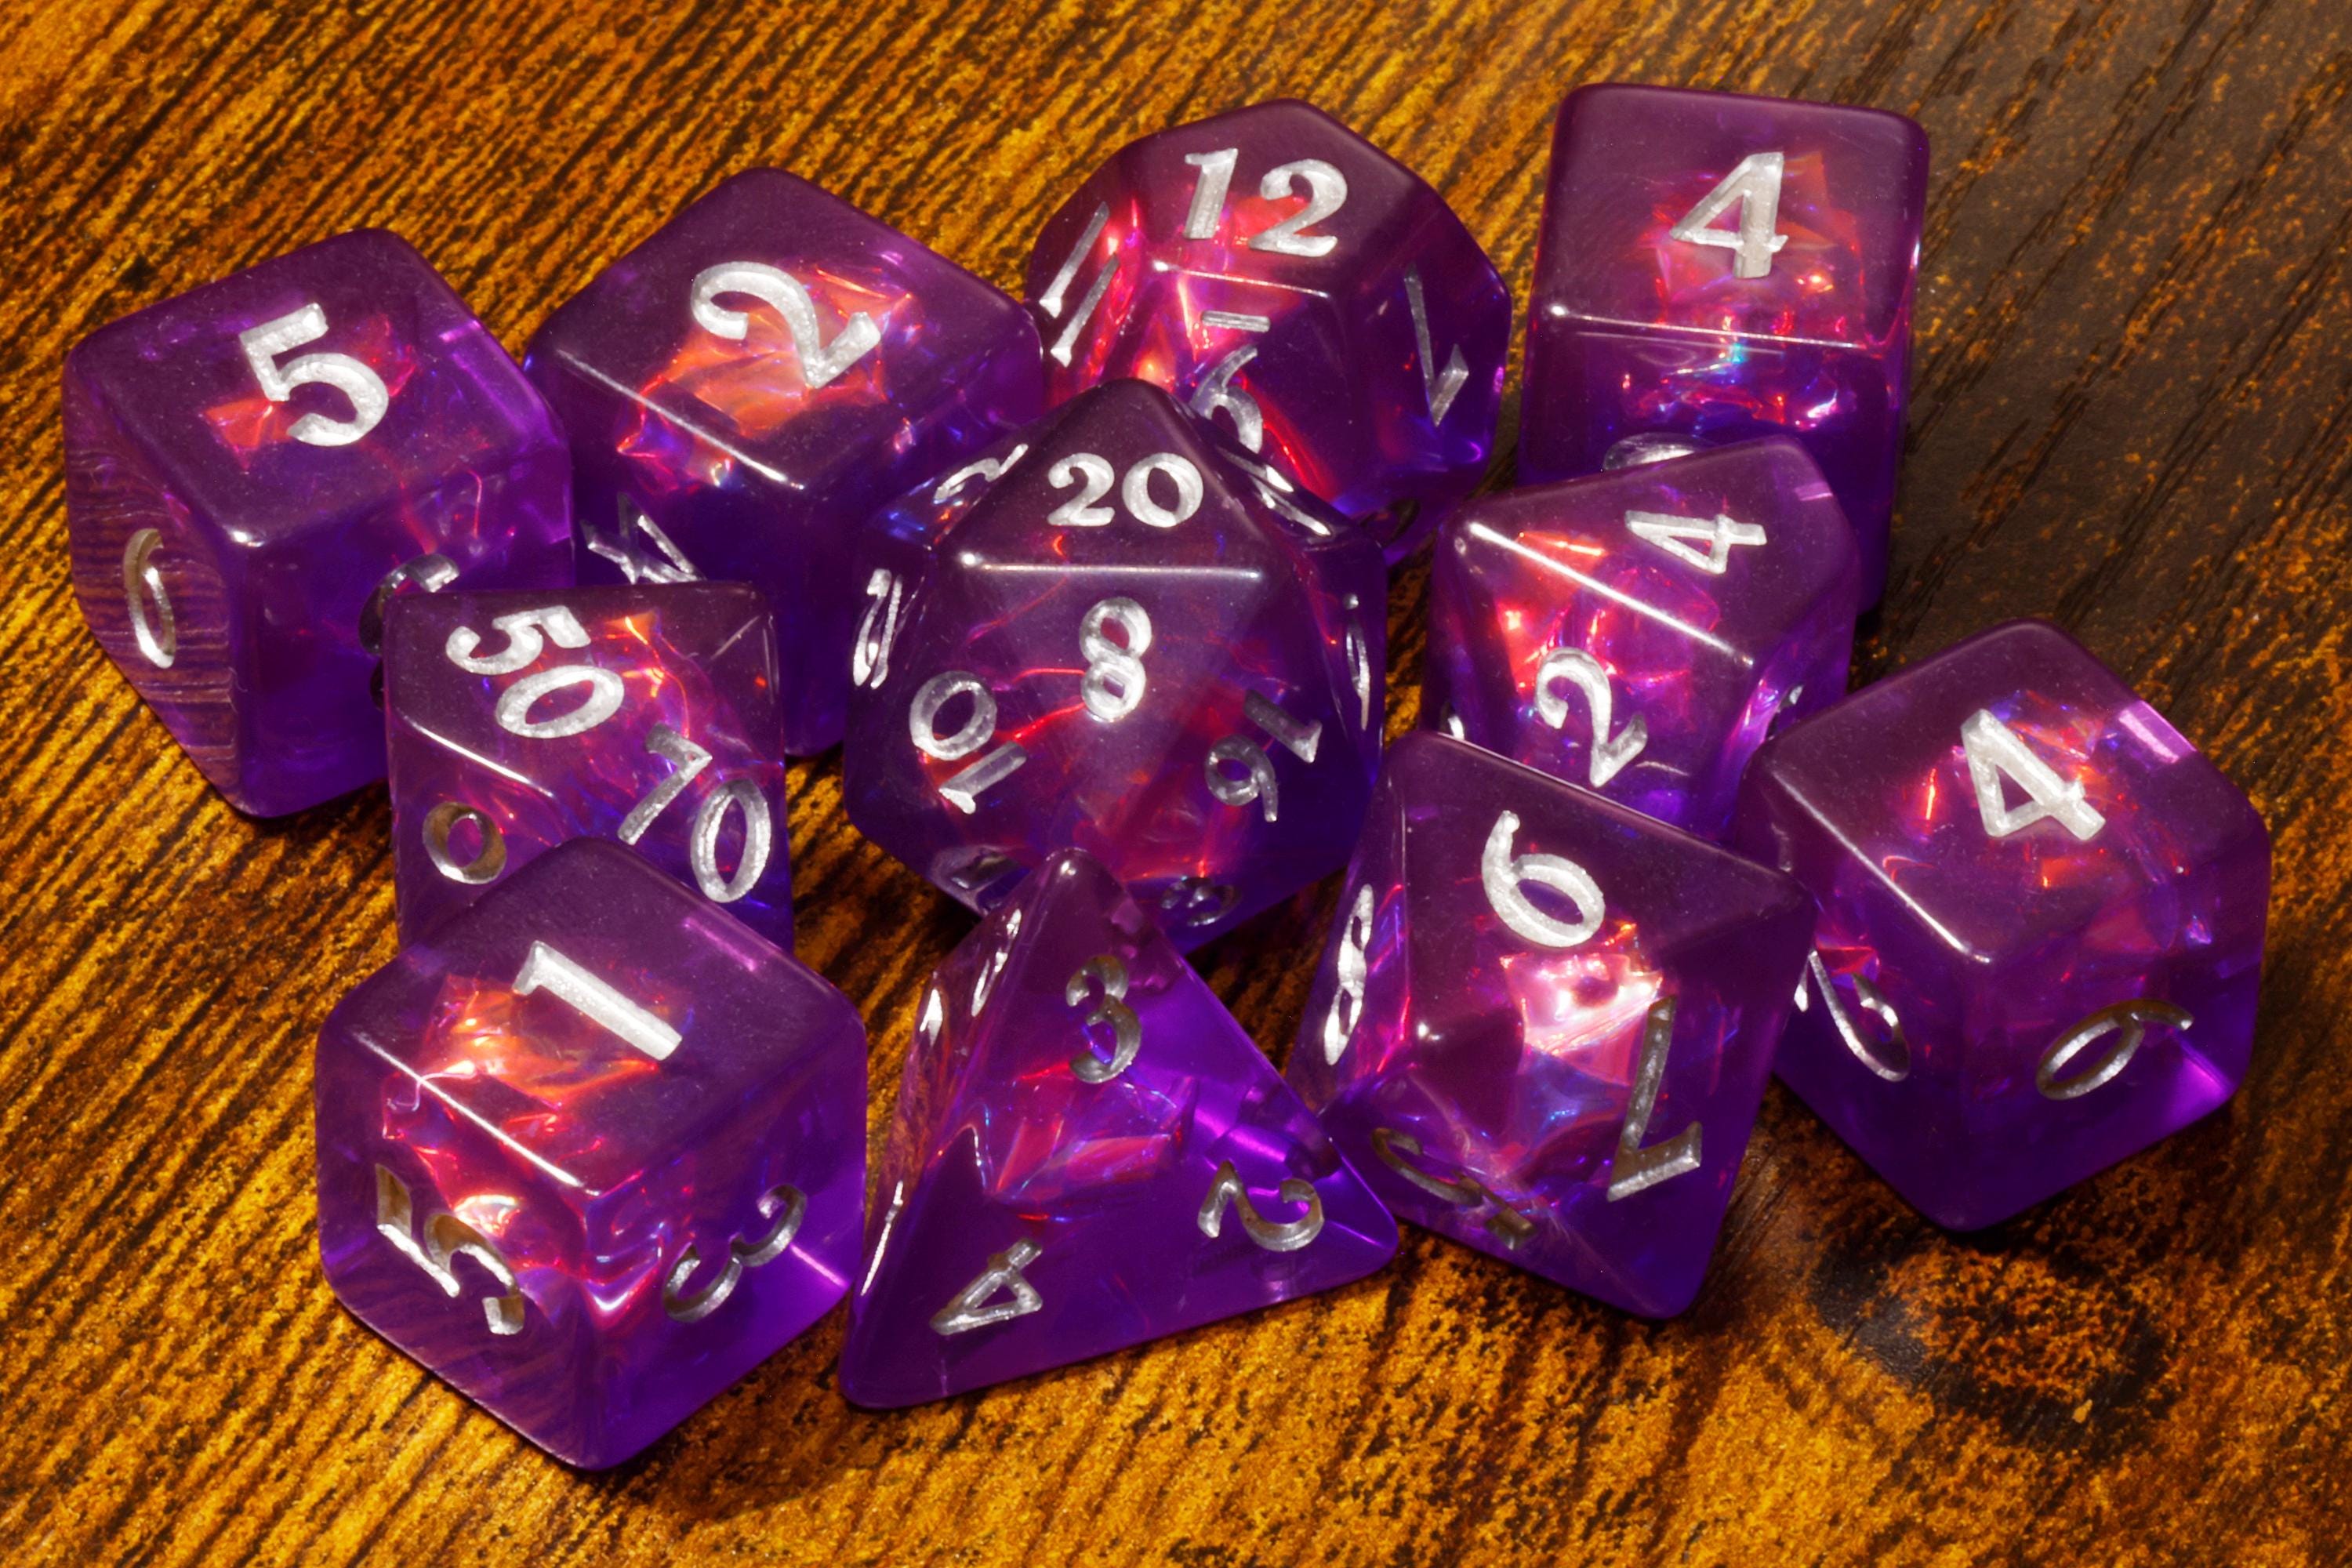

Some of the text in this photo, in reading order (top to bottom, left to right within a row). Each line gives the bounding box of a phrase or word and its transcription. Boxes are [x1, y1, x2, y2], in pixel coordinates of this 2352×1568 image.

[1183, 147, 1348, 257] 12
[1669, 152, 1788, 278] 4
[691, 261, 880, 388] 2
[1039, 201, 1120, 367] 11
[239, 303, 390, 447] 5
[1048, 452, 1203, 528] 20
[1624, 510, 1767, 574] 4
[445, 605, 625, 739] 50
[1079, 597, 1152, 722] 8
[1535, 647, 1647, 788] 2
[909, 671, 1027, 814] 10
[1961, 709, 2107, 841] 4
[617, 723, 772, 903] 70
[1482, 810, 1606, 948] 6
[511, 941, 683, 1061] 1
[1066, 955, 1142, 1084] 3
[1607, 993, 1703, 1203] 7
[375, 1163, 525, 1336] 5
[662, 1183, 808, 1323] 3
[1197, 1159, 1325, 1252] 2
[930, 1238, 1044, 1335] 4
